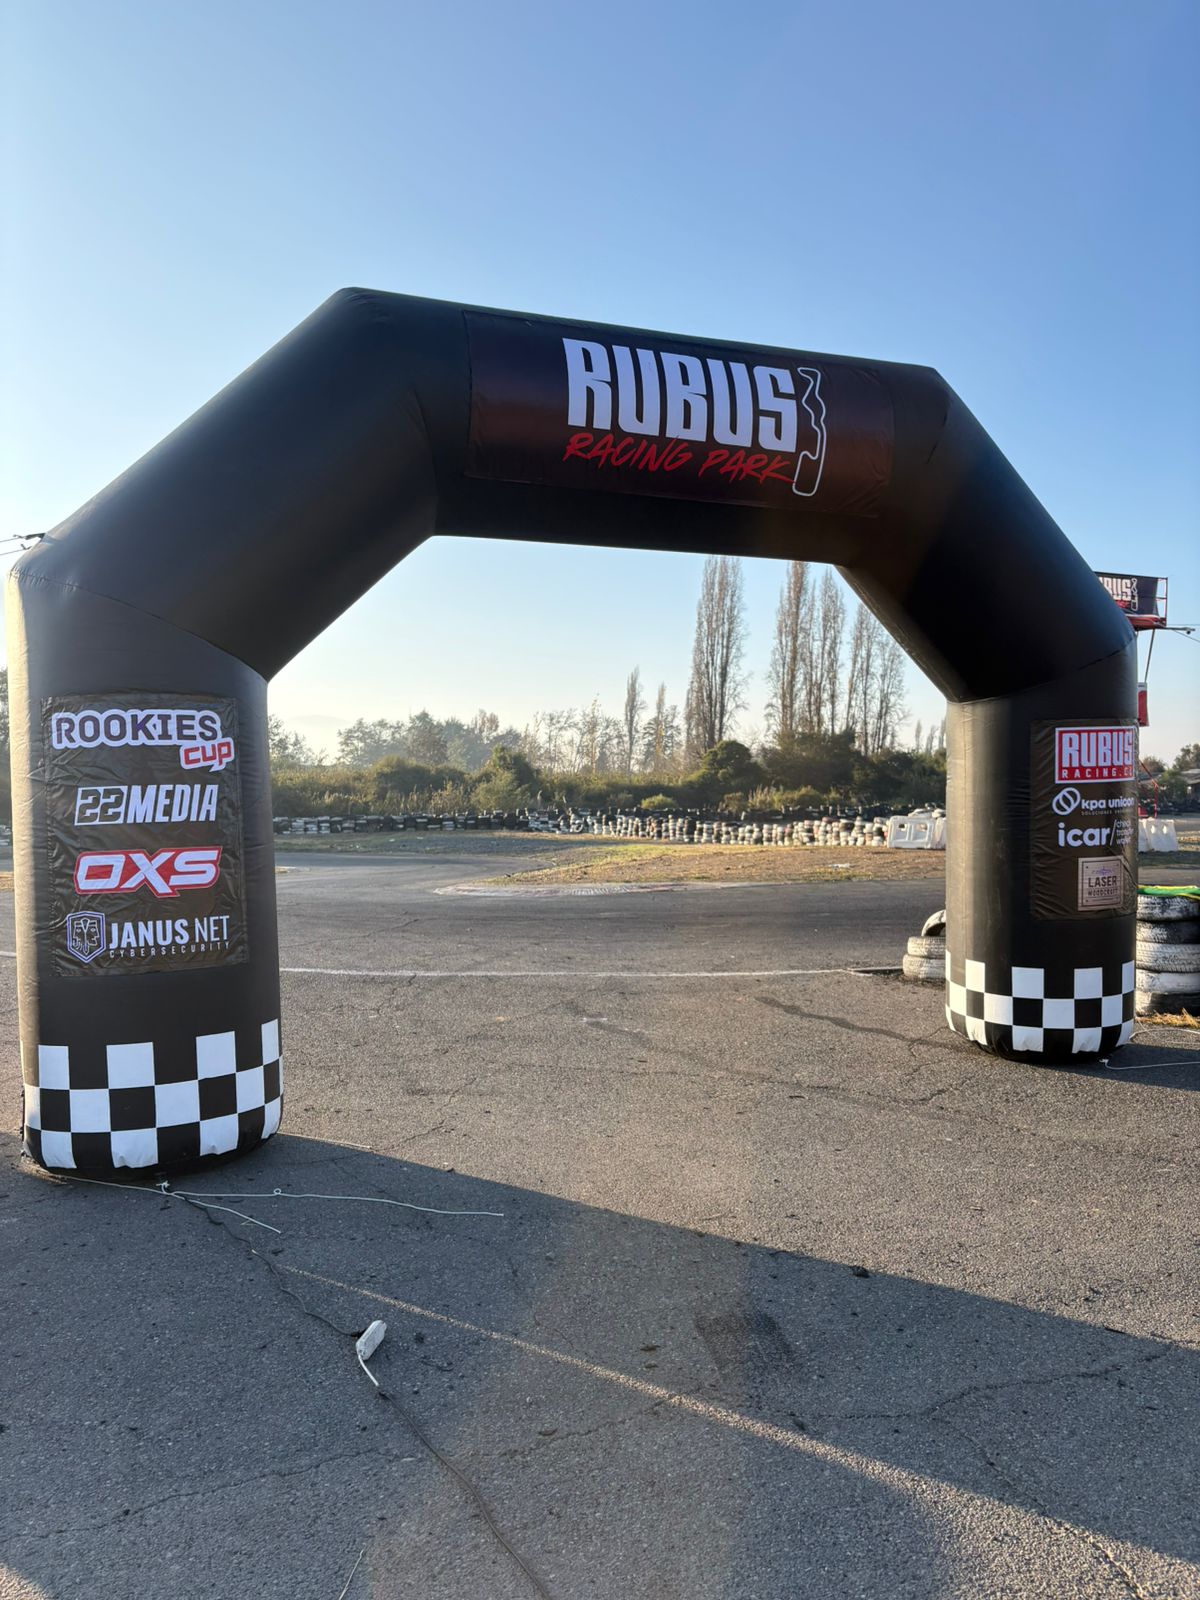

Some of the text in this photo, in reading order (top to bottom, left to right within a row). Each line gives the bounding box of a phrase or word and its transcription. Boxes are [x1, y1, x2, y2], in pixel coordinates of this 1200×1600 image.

[562, 338, 797, 453] RUBUS
[562, 433, 796, 484] RACING PARK
[1098, 576, 1131, 601] BUS
[55, 713, 219, 745] ROOKIES
[1061, 731, 1133, 767] RUBUS
[1081, 799, 1106, 811] kpa
[1058, 822, 1111, 847] icar
[76, 850, 219, 893] OXS
[1088, 876, 1117, 888] LASER
[109, 915, 230, 948] JANUS NET
[109, 941, 230, 958] CYBERSECURITY
